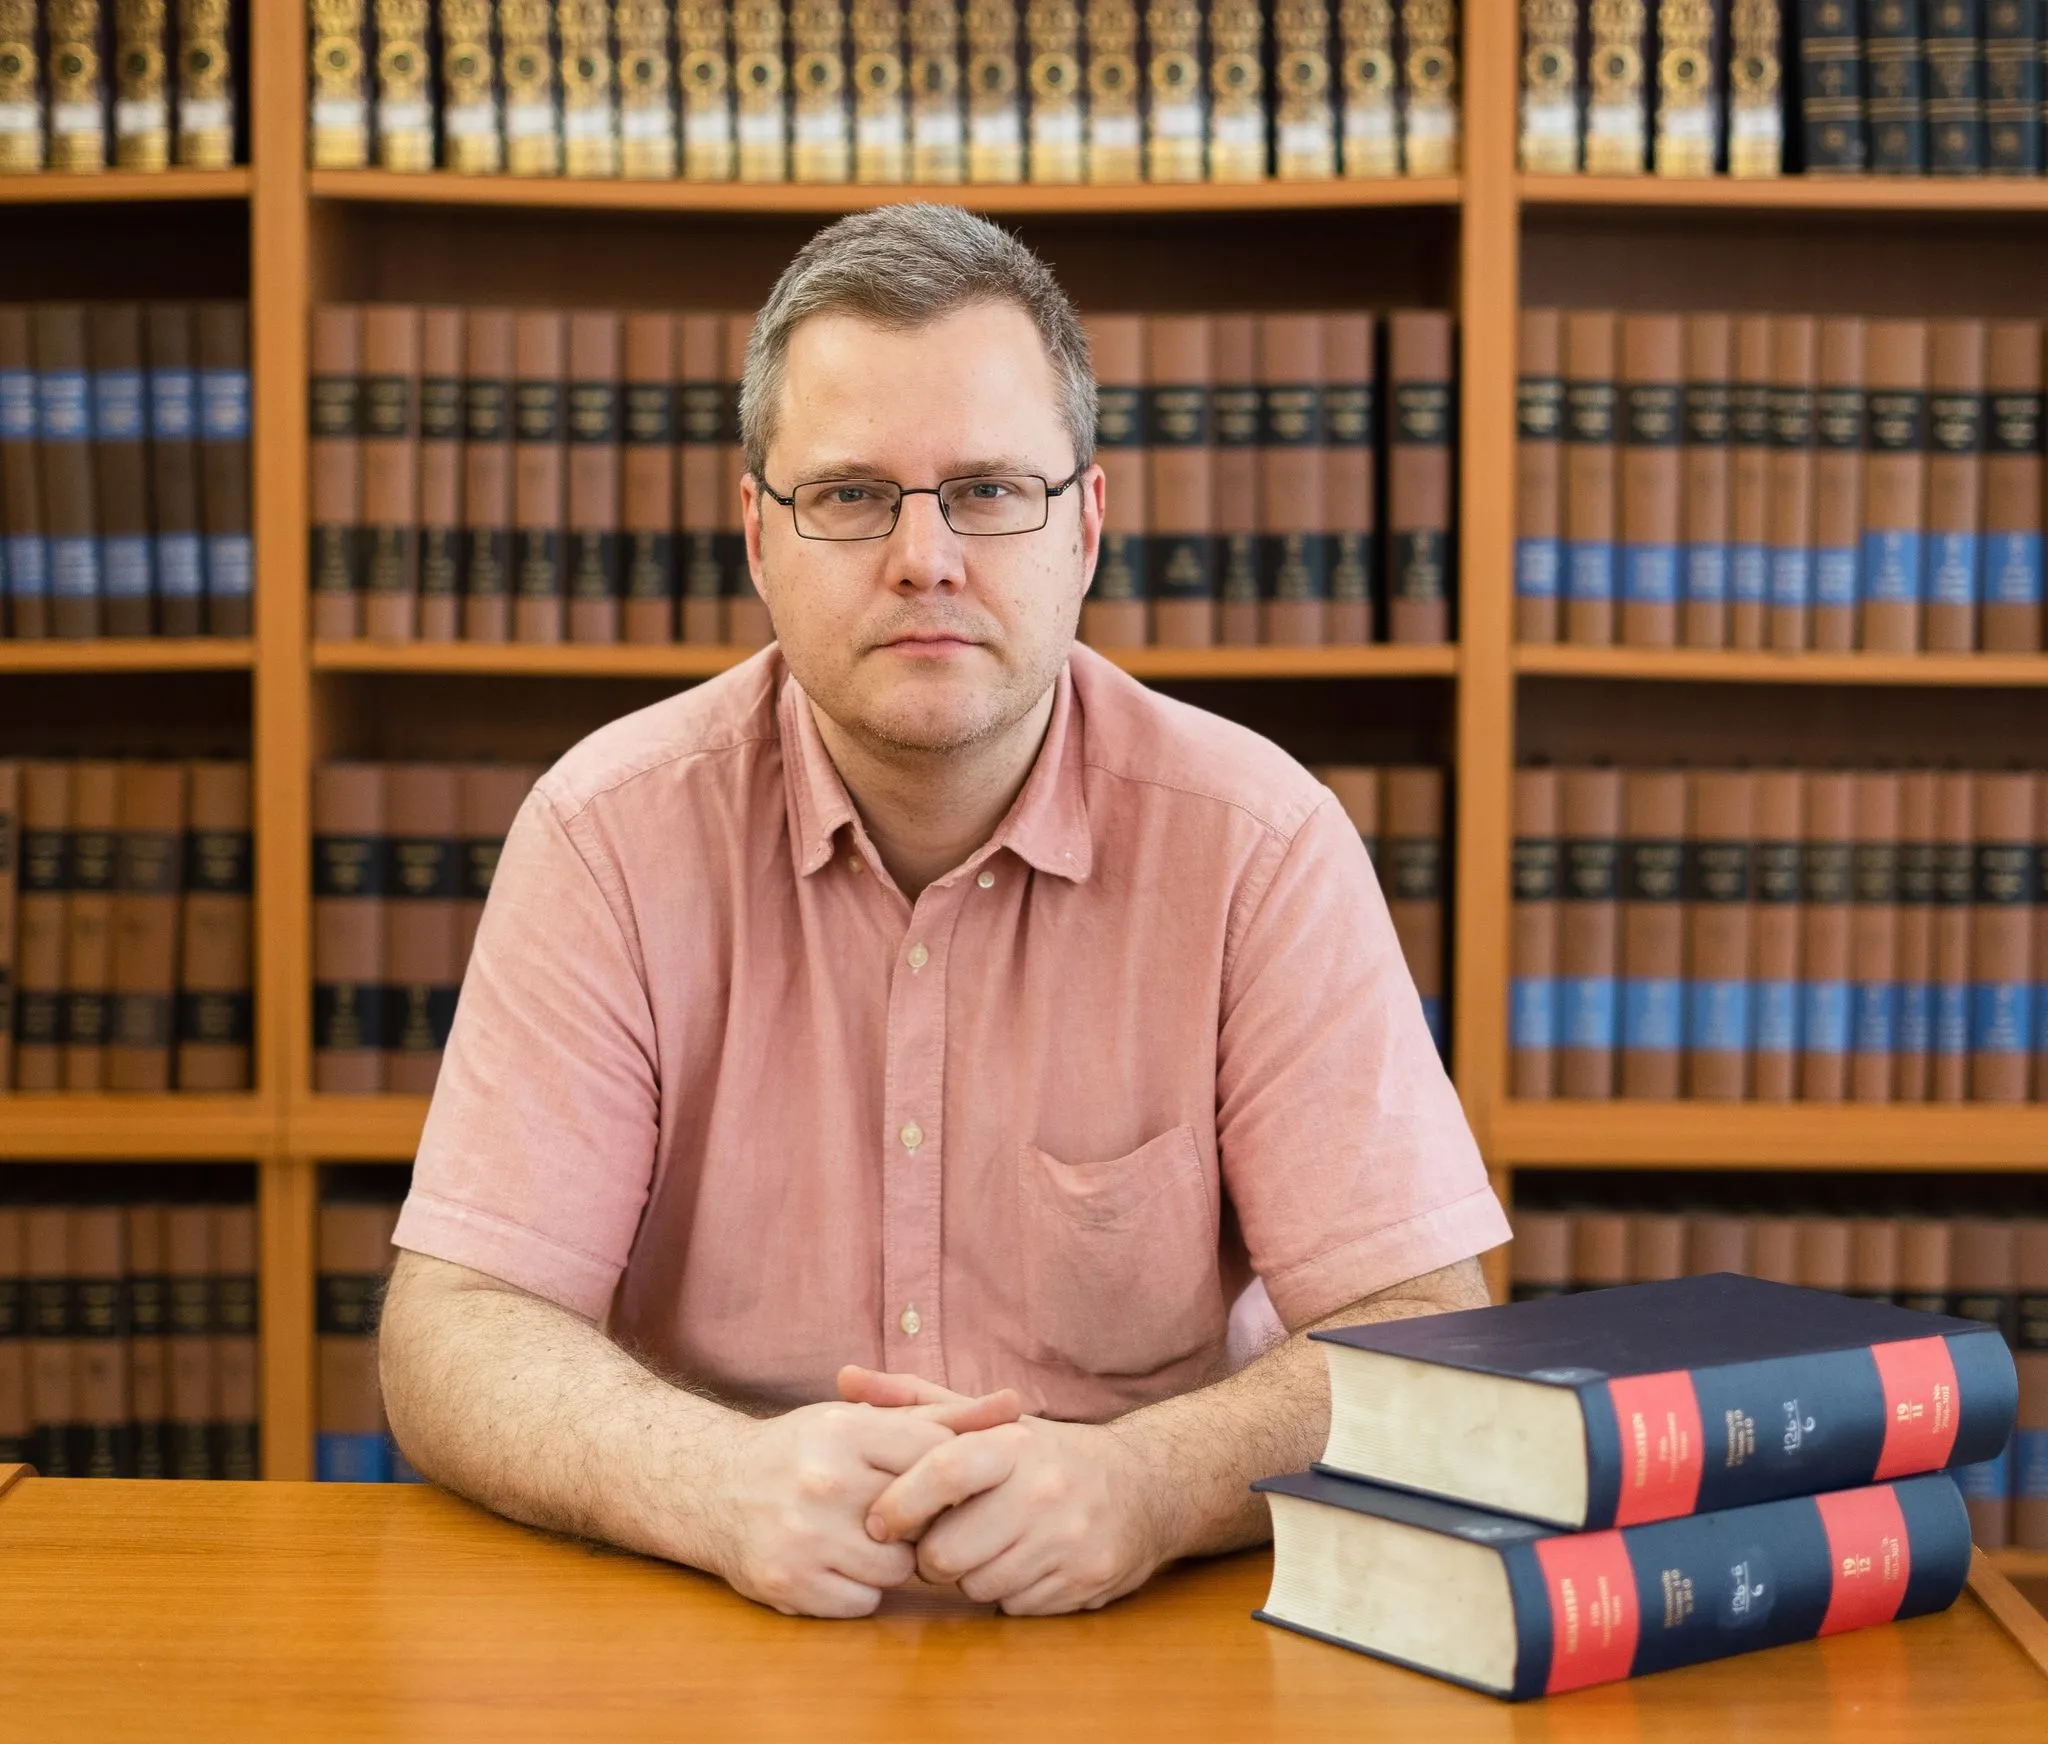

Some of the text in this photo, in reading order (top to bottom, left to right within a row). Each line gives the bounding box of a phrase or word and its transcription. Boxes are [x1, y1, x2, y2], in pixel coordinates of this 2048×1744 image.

[1896, 1402, 1909, 1423] 19
[1911, 1403, 1923, 1419] 11
[1802, 1416, 1816, 1433] 6
[1842, 1556, 1857, 1578] 19
[1858, 1557, 1871, 1573] 12
[1751, 1583, 1764, 1598] 6
